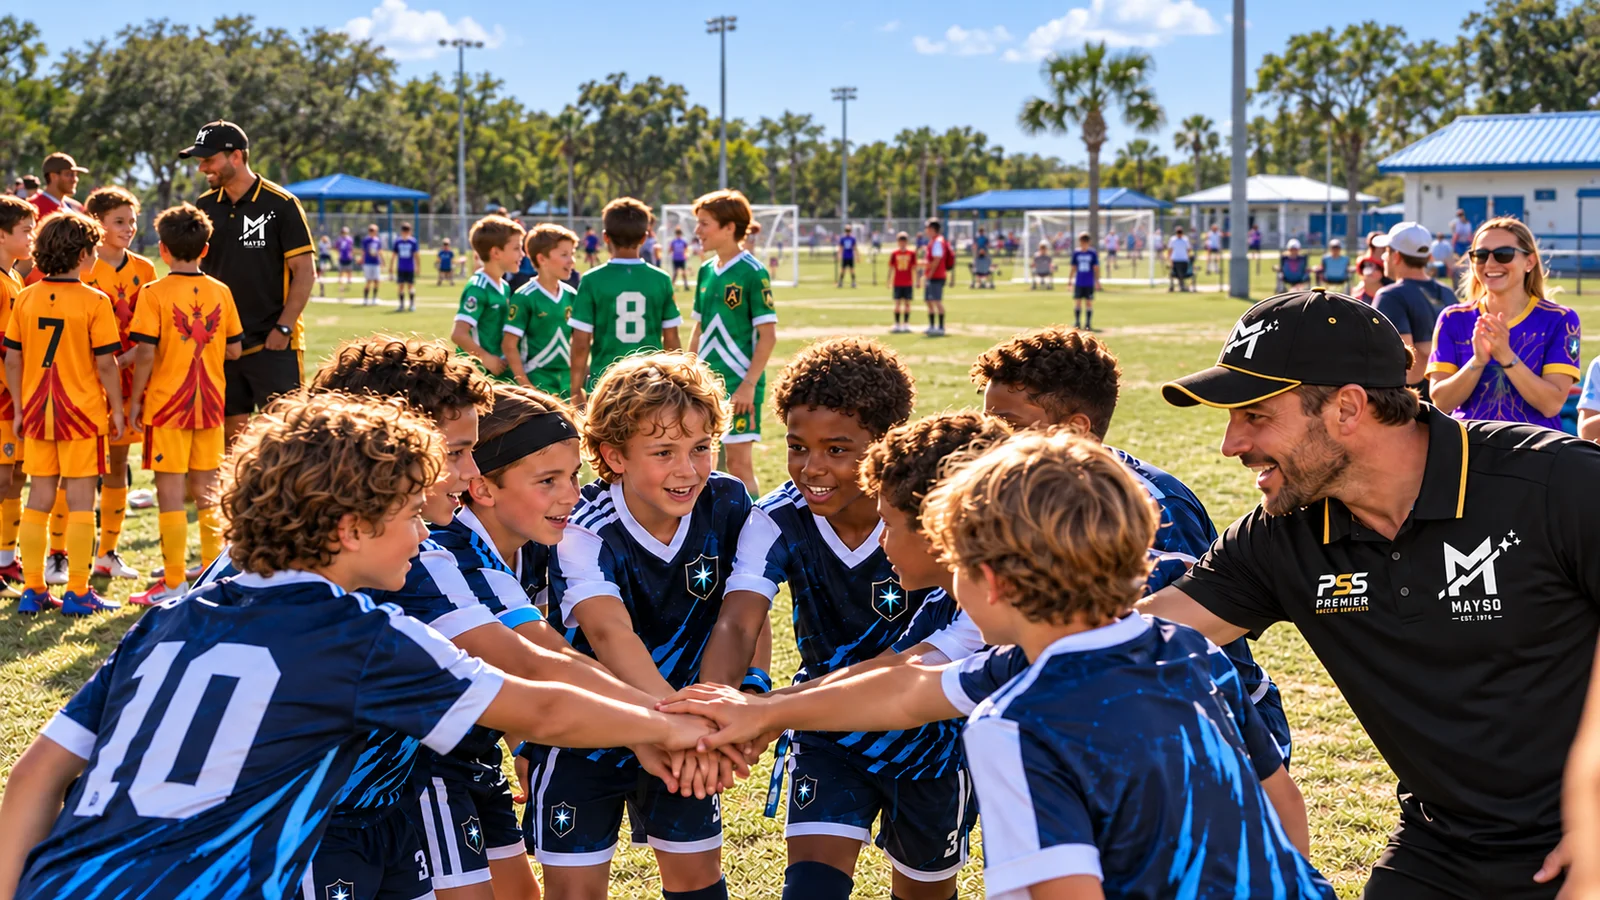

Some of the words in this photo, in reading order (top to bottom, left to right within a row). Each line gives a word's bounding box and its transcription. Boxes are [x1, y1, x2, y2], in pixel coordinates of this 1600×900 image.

[727, 289, 738, 303] A
[615, 291, 646, 343] 8
[38, 316, 65, 368] 7
[1316, 572, 1369, 597] PSS
[1315, 596, 1369, 609] PREMIER
[1451, 598, 1502, 613] MAYSO
[73, 640, 282, 820] 10
[712, 792, 721, 823] 3
[943, 829, 959, 858] 3
[414, 849, 430, 881] 3
